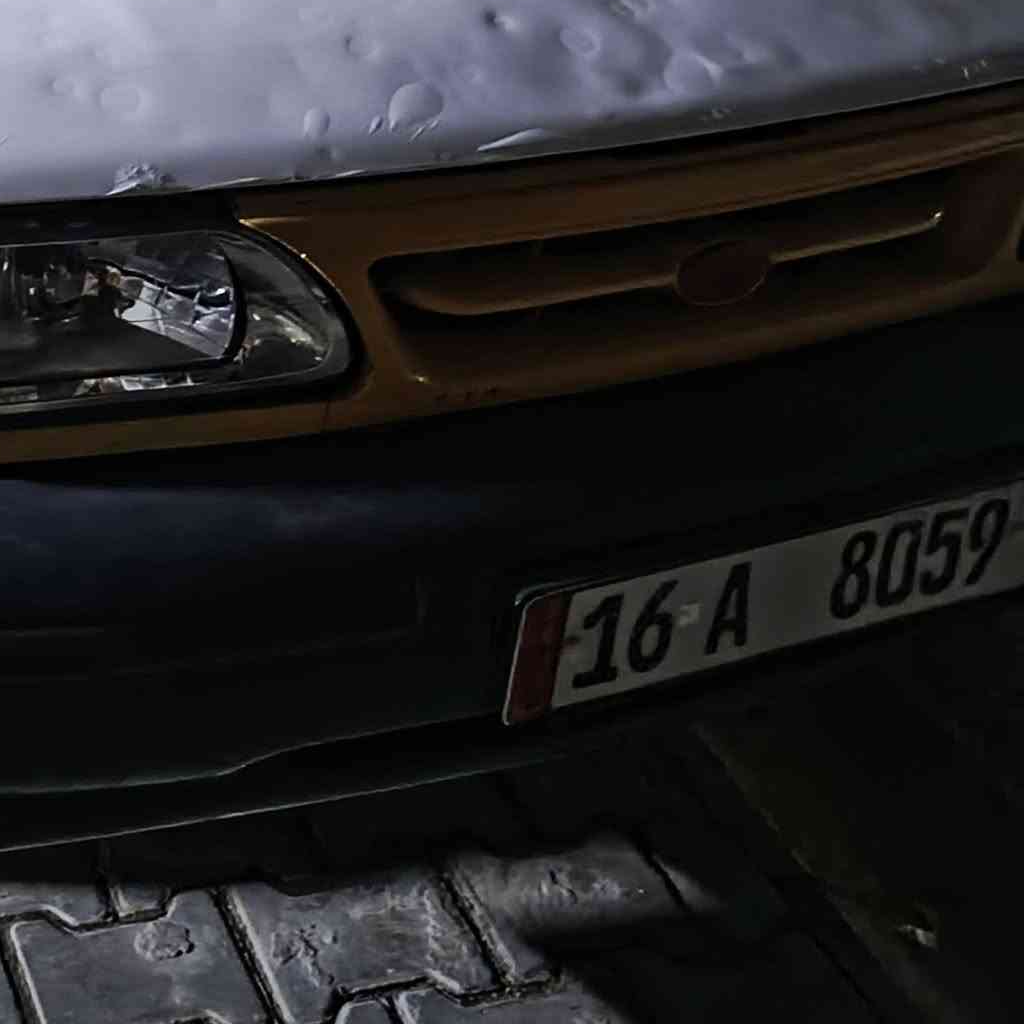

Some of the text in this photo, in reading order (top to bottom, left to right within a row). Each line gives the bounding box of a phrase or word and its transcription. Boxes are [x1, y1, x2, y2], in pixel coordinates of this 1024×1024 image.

[572, 496, 1009, 690] 16 A 8059
